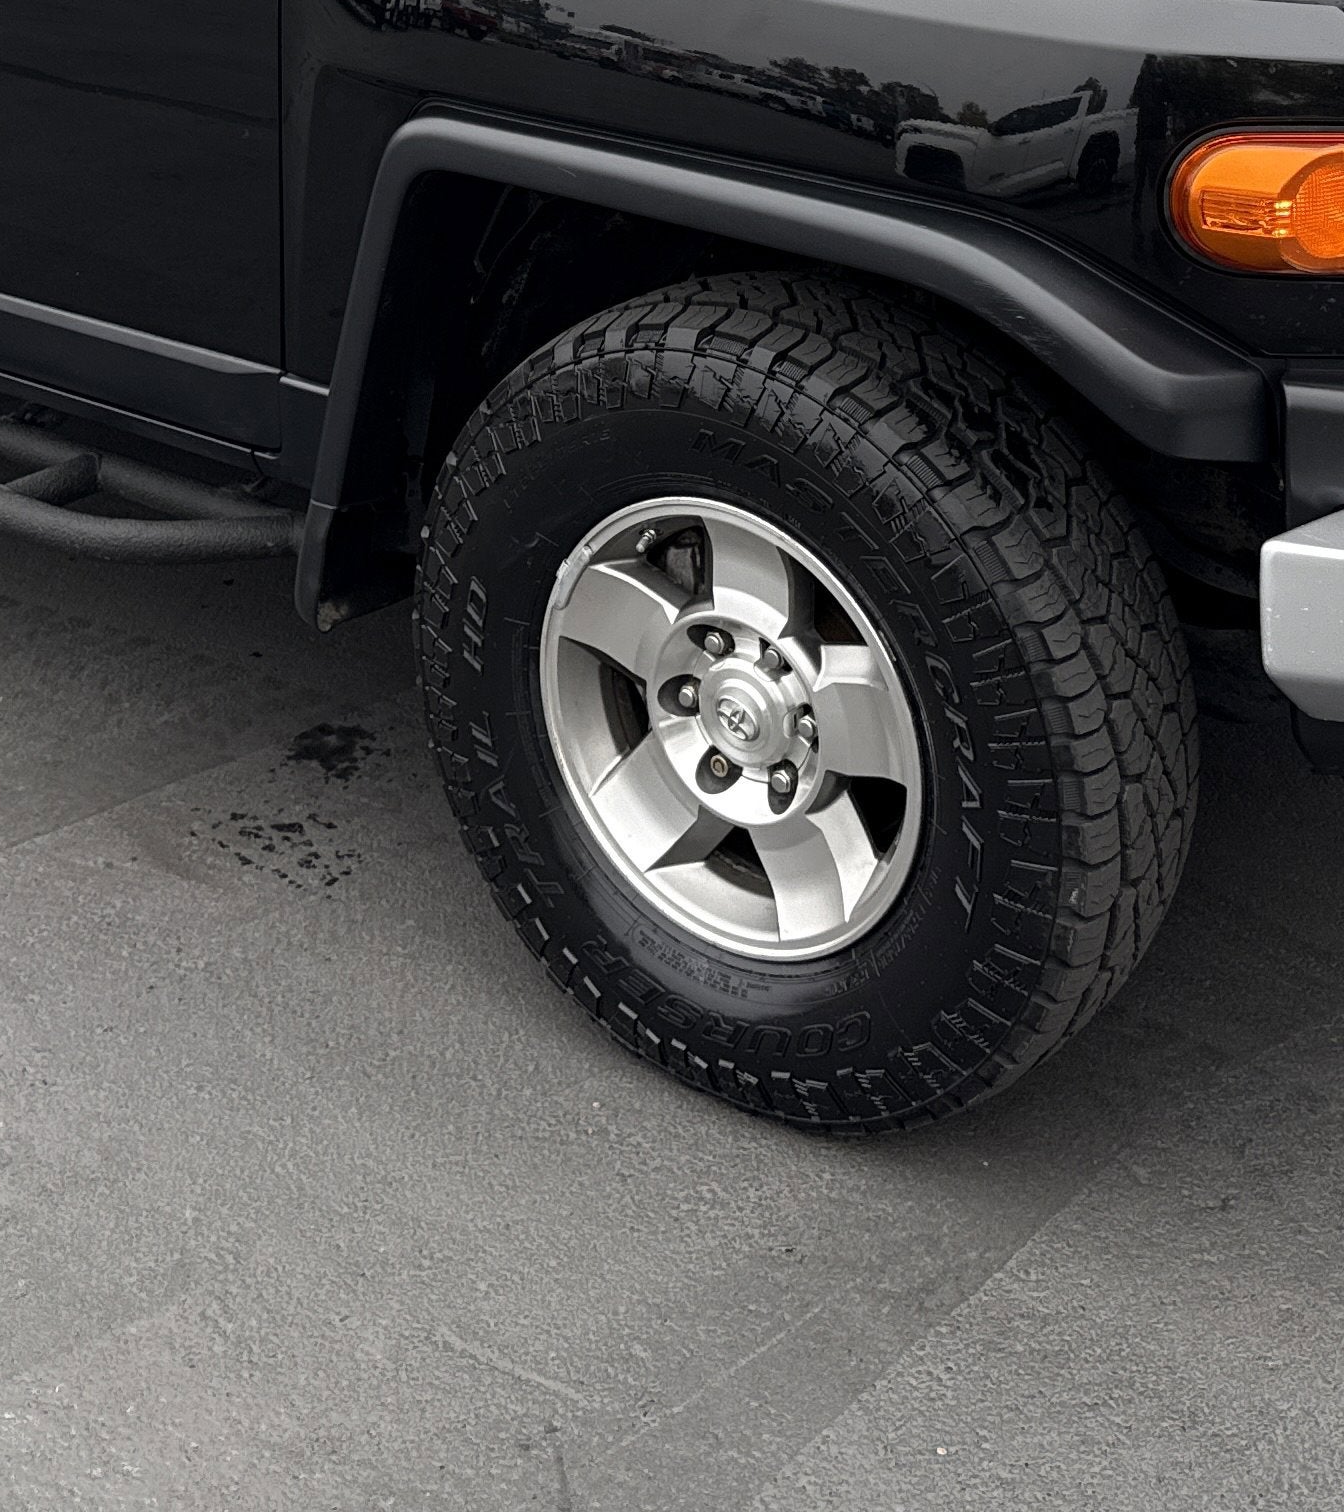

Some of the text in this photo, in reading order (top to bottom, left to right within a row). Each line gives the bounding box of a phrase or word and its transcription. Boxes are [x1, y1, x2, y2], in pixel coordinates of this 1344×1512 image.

[462, 575, 488, 673] HD
[691, 428, 983, 933] MASTERCRAFT
[468, 711, 564, 908] TRAIL
[581, 940, 872, 1059] COURSER
